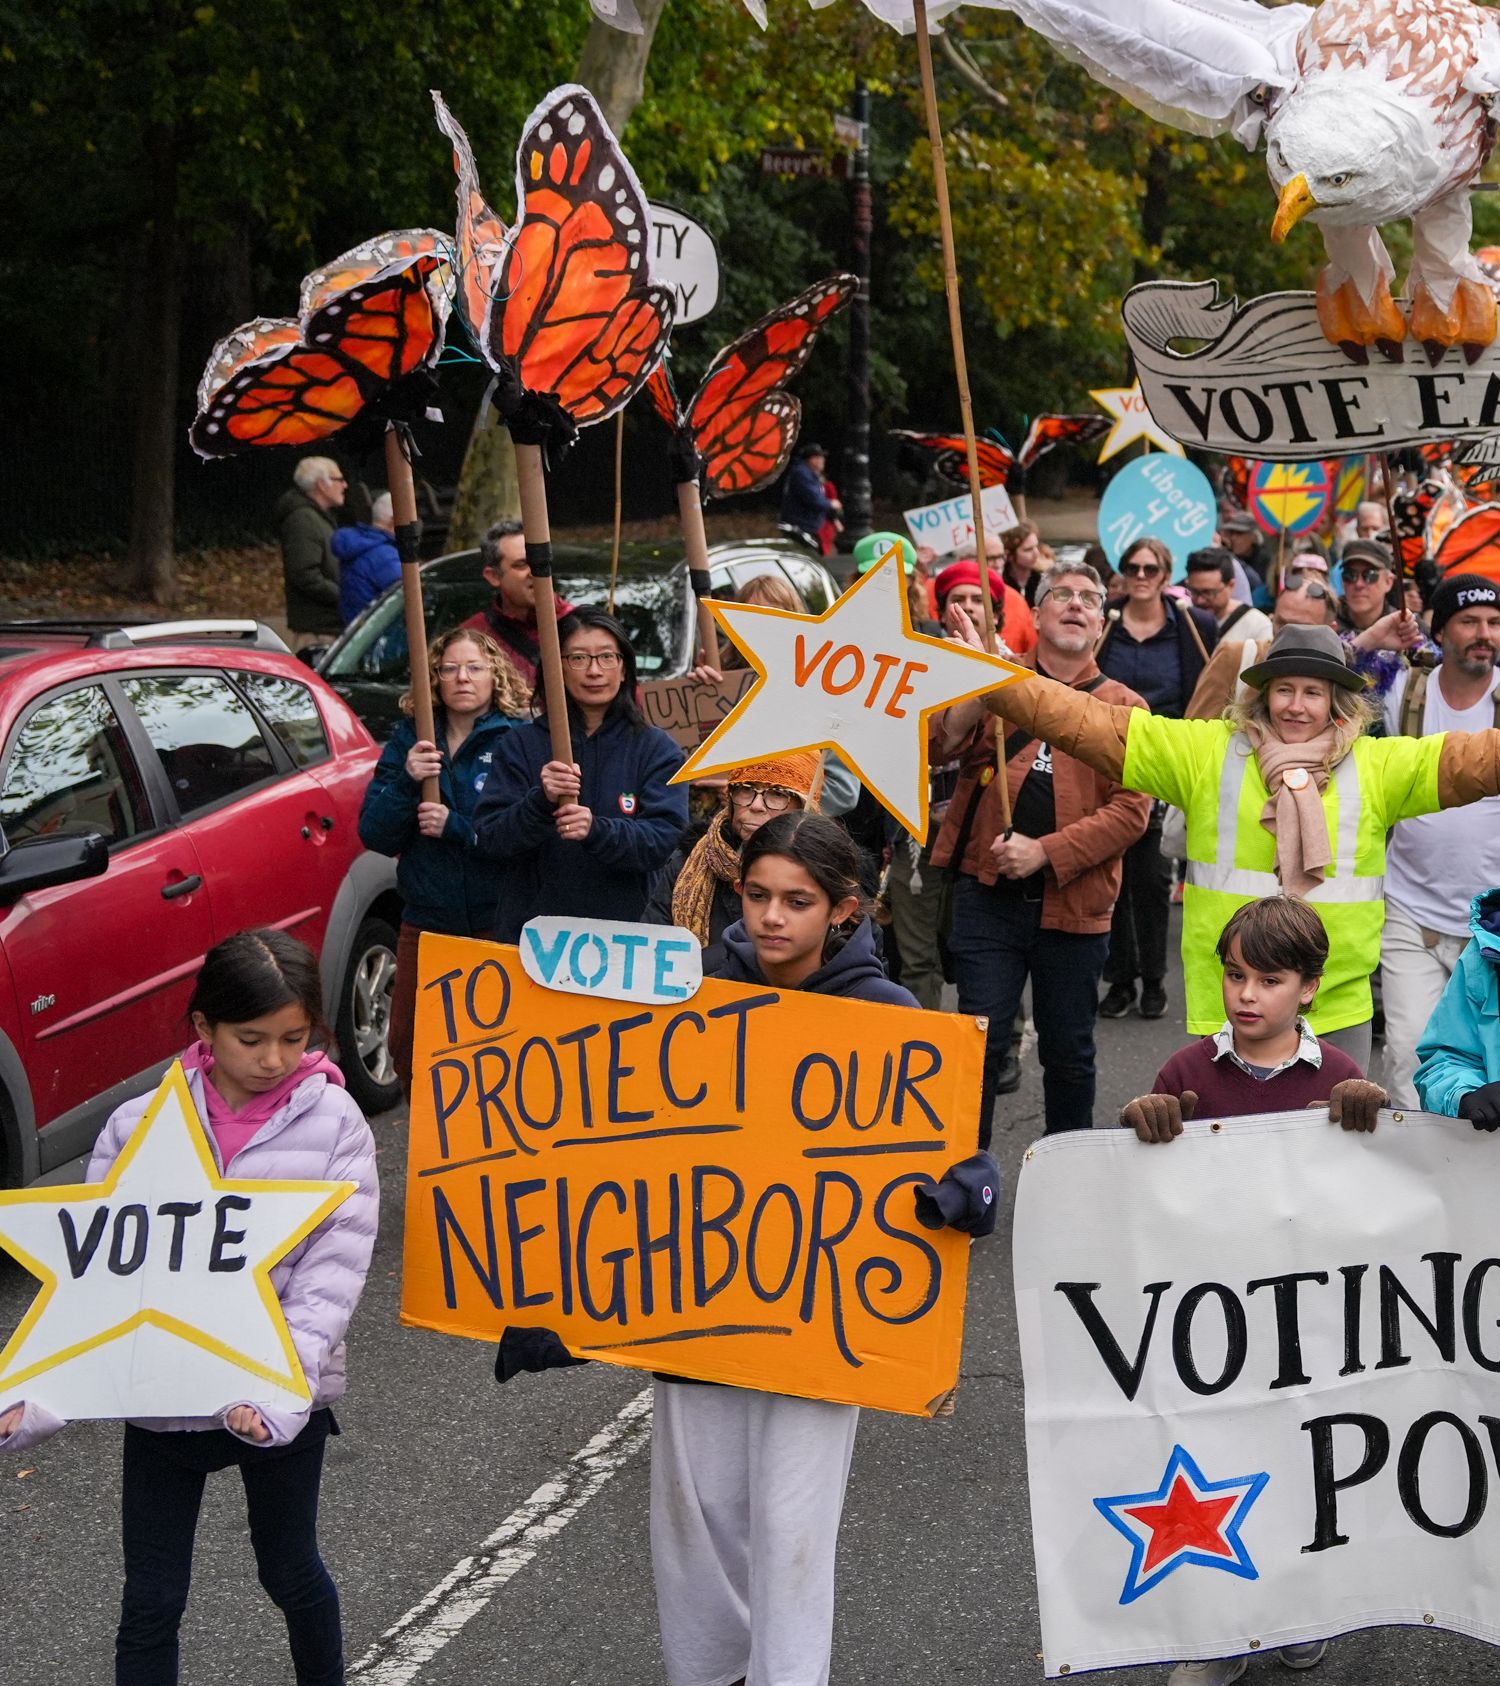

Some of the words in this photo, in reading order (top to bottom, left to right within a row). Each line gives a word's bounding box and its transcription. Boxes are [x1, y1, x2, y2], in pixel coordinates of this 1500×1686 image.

[1120, 396, 1147, 413] VO
[1163, 377, 1384, 443] VOTE
[909, 499, 971, 532] VOTE
[1140, 458, 1209, 537] Liberty
[1147, 499, 1169, 524] 4
[795, 634, 928, 718] VOTE
[424, 960, 511, 1043] TO
[524, 928, 691, 998] VOTE
[430, 992, 780, 1158] PROTECT
[792, 1040, 944, 1131] OUR
[58, 1195, 251, 1279] VOTE
[433, 1164, 943, 1368] NEIGHBORS
